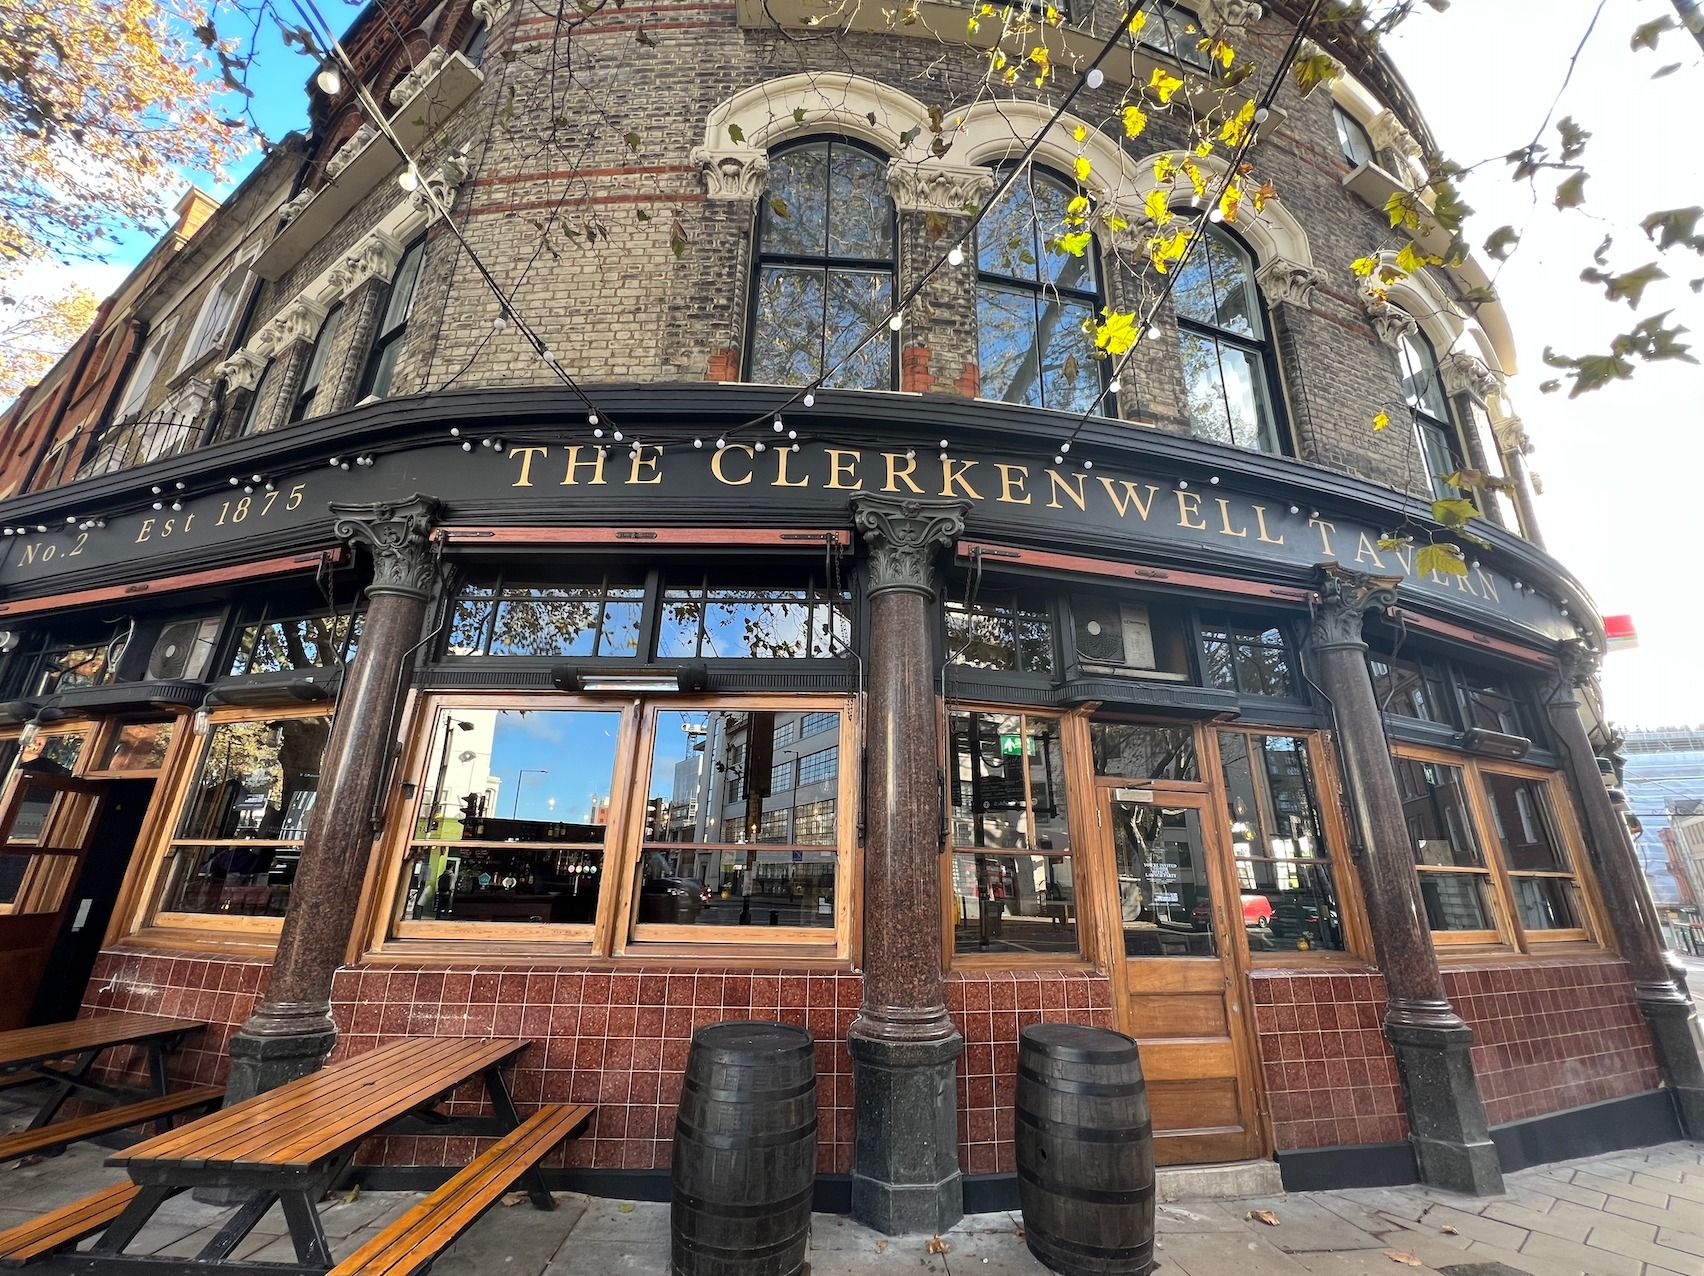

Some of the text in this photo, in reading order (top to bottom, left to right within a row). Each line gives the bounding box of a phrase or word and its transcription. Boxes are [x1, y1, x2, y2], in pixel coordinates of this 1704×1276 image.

[135, 484, 306, 543] Est 1875
[508, 444, 664, 487] THE
[710, 443, 1284, 545] CLERKENWELL
[17, 532, 89, 567] No.2
